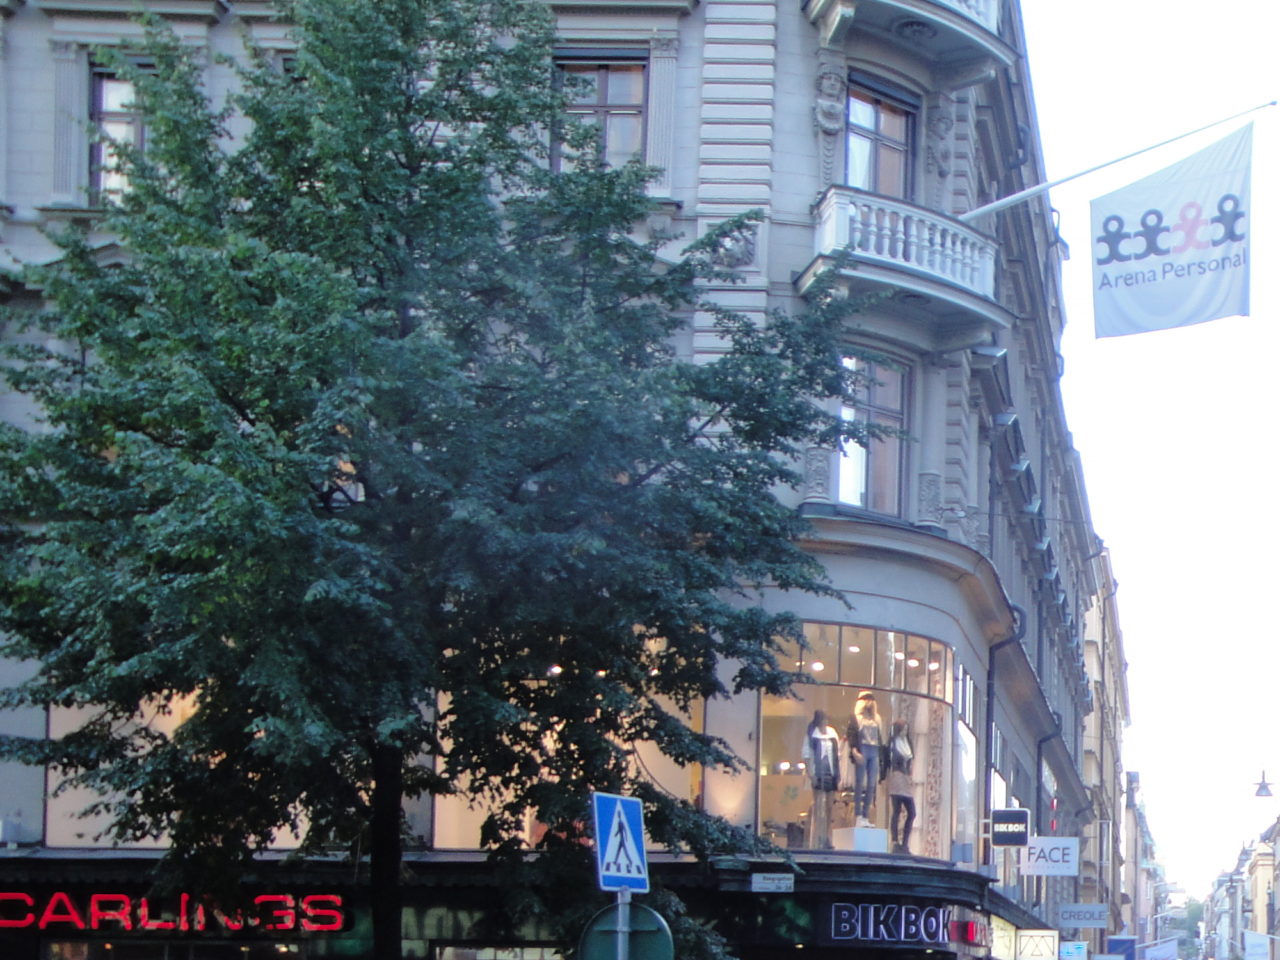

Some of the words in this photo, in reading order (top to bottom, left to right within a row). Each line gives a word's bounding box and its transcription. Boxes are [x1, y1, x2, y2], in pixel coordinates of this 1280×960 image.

[1098, 269, 1157, 290] Arena
[1162, 247, 1246, 280] Personal
[993, 823, 1008, 832] BIK
[1008, 823, 1026, 832] BOK
[1027, 846, 1071, 863] FACE
[831, 903, 898, 941] BIK
[901, 905, 951, 943] BOK
[1061, 910, 1106, 920] CREOLE
